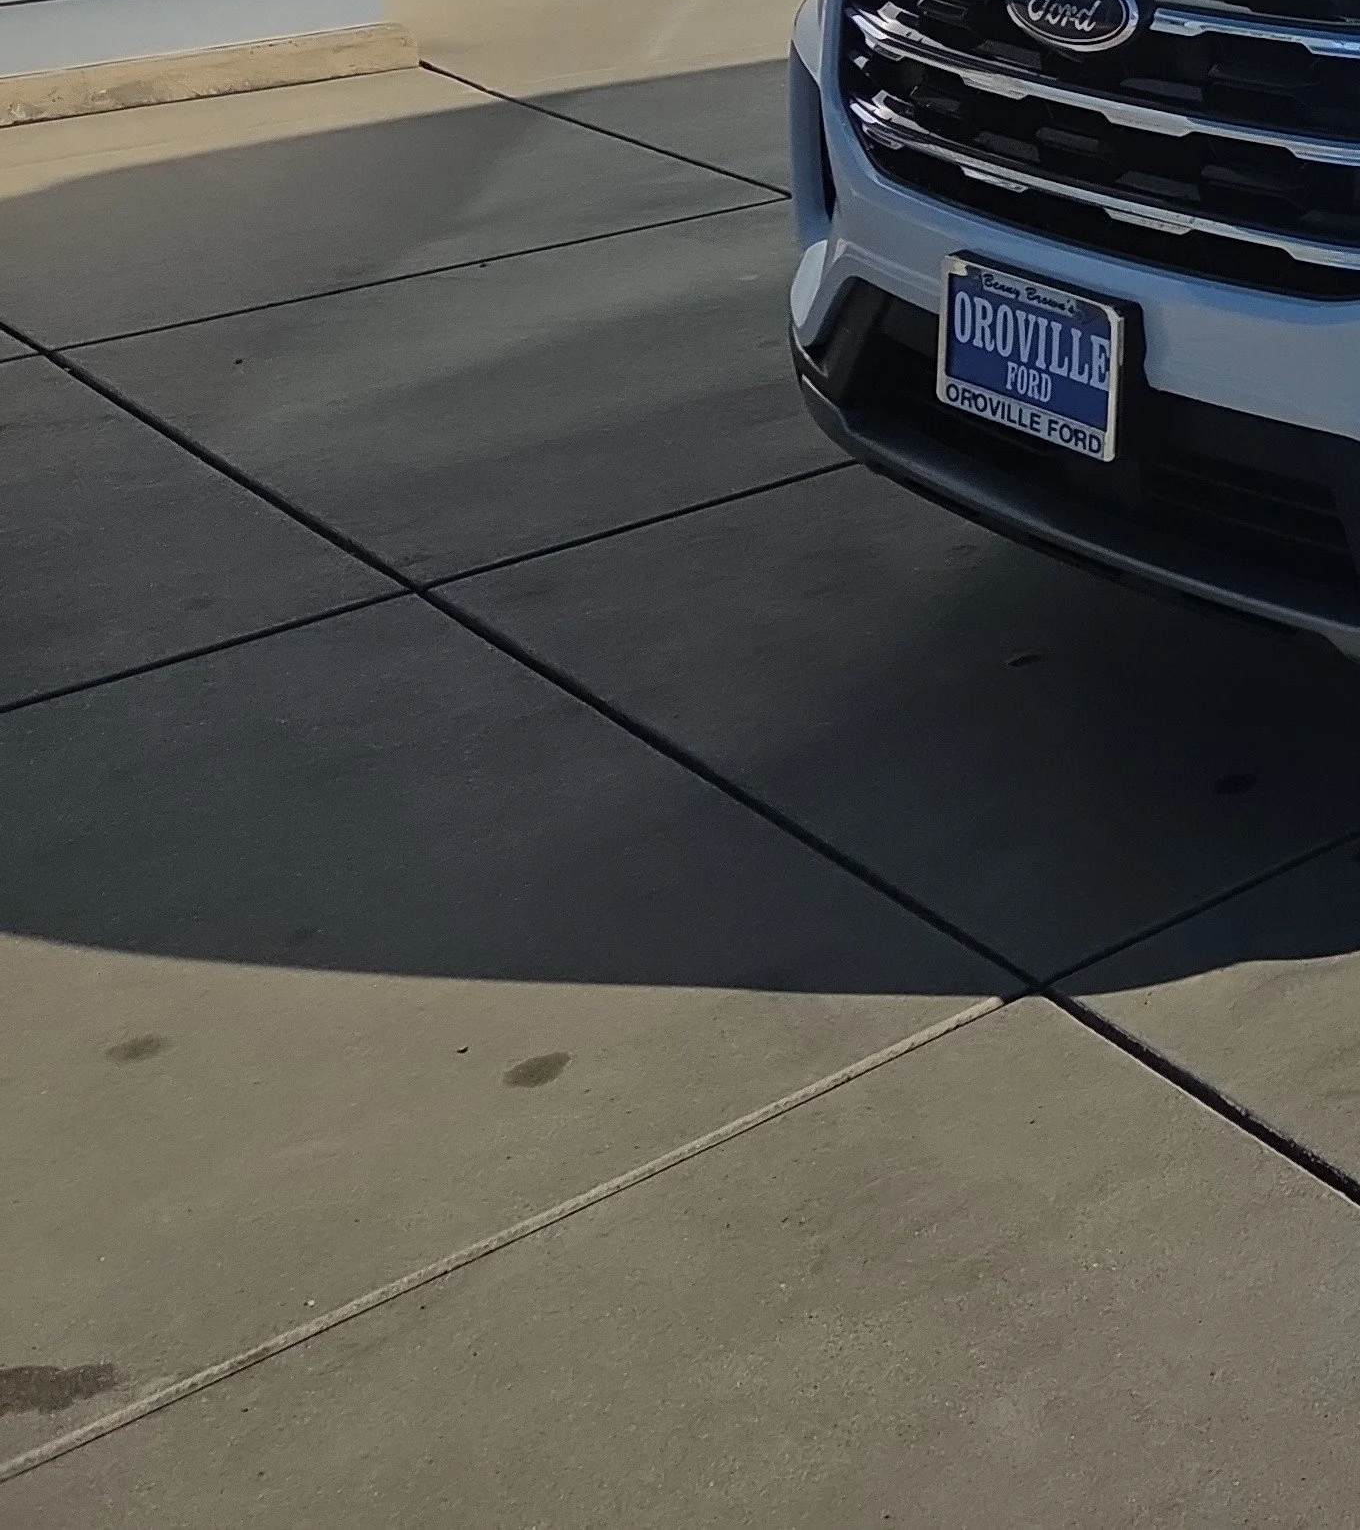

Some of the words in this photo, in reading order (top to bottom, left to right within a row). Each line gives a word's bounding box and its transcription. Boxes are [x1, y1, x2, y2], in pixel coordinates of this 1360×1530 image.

[953, 290, 1110, 392] OROVILLE
[1005, 361, 1052, 404] FORD
[945, 383, 1041, 433] OROVILLE
[1046, 418, 1102, 455] FORD
